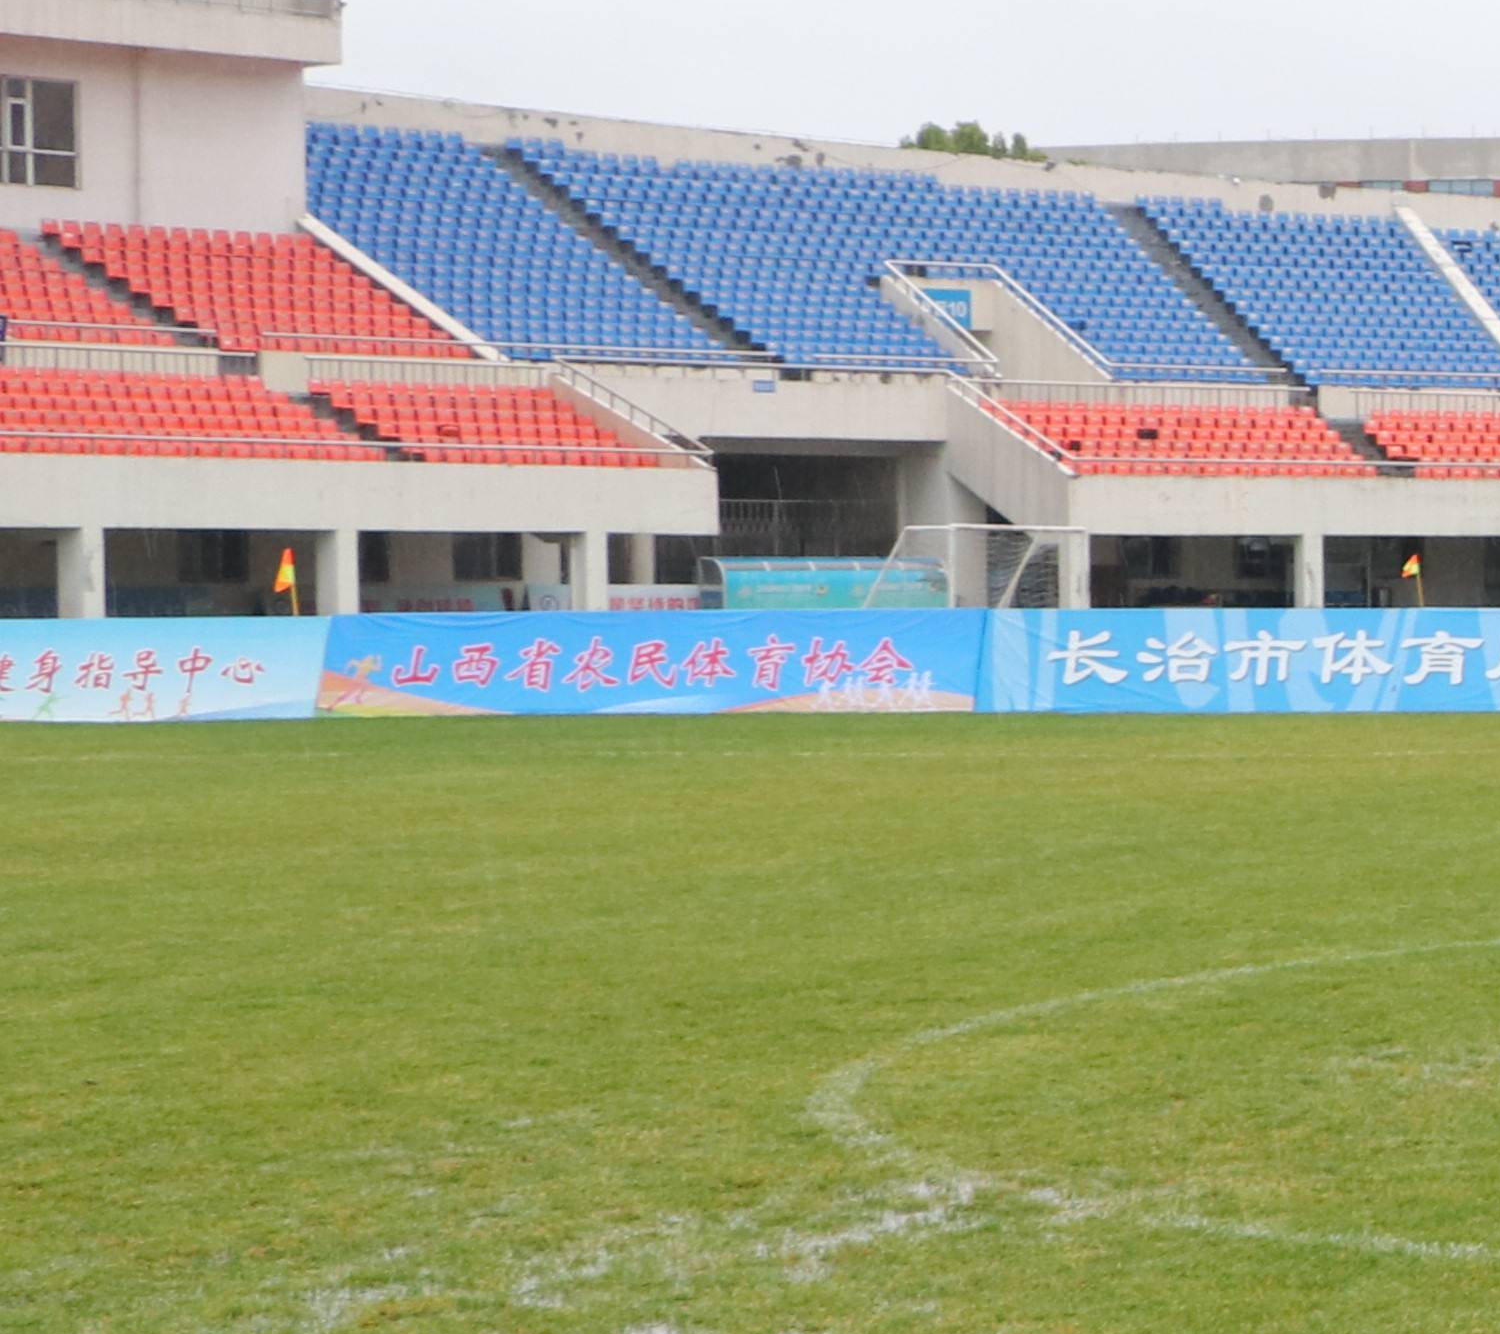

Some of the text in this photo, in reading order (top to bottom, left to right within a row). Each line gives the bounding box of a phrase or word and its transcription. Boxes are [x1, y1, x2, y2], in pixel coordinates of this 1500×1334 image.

[391, 637, 913, 691] 山西省农民体育协会
